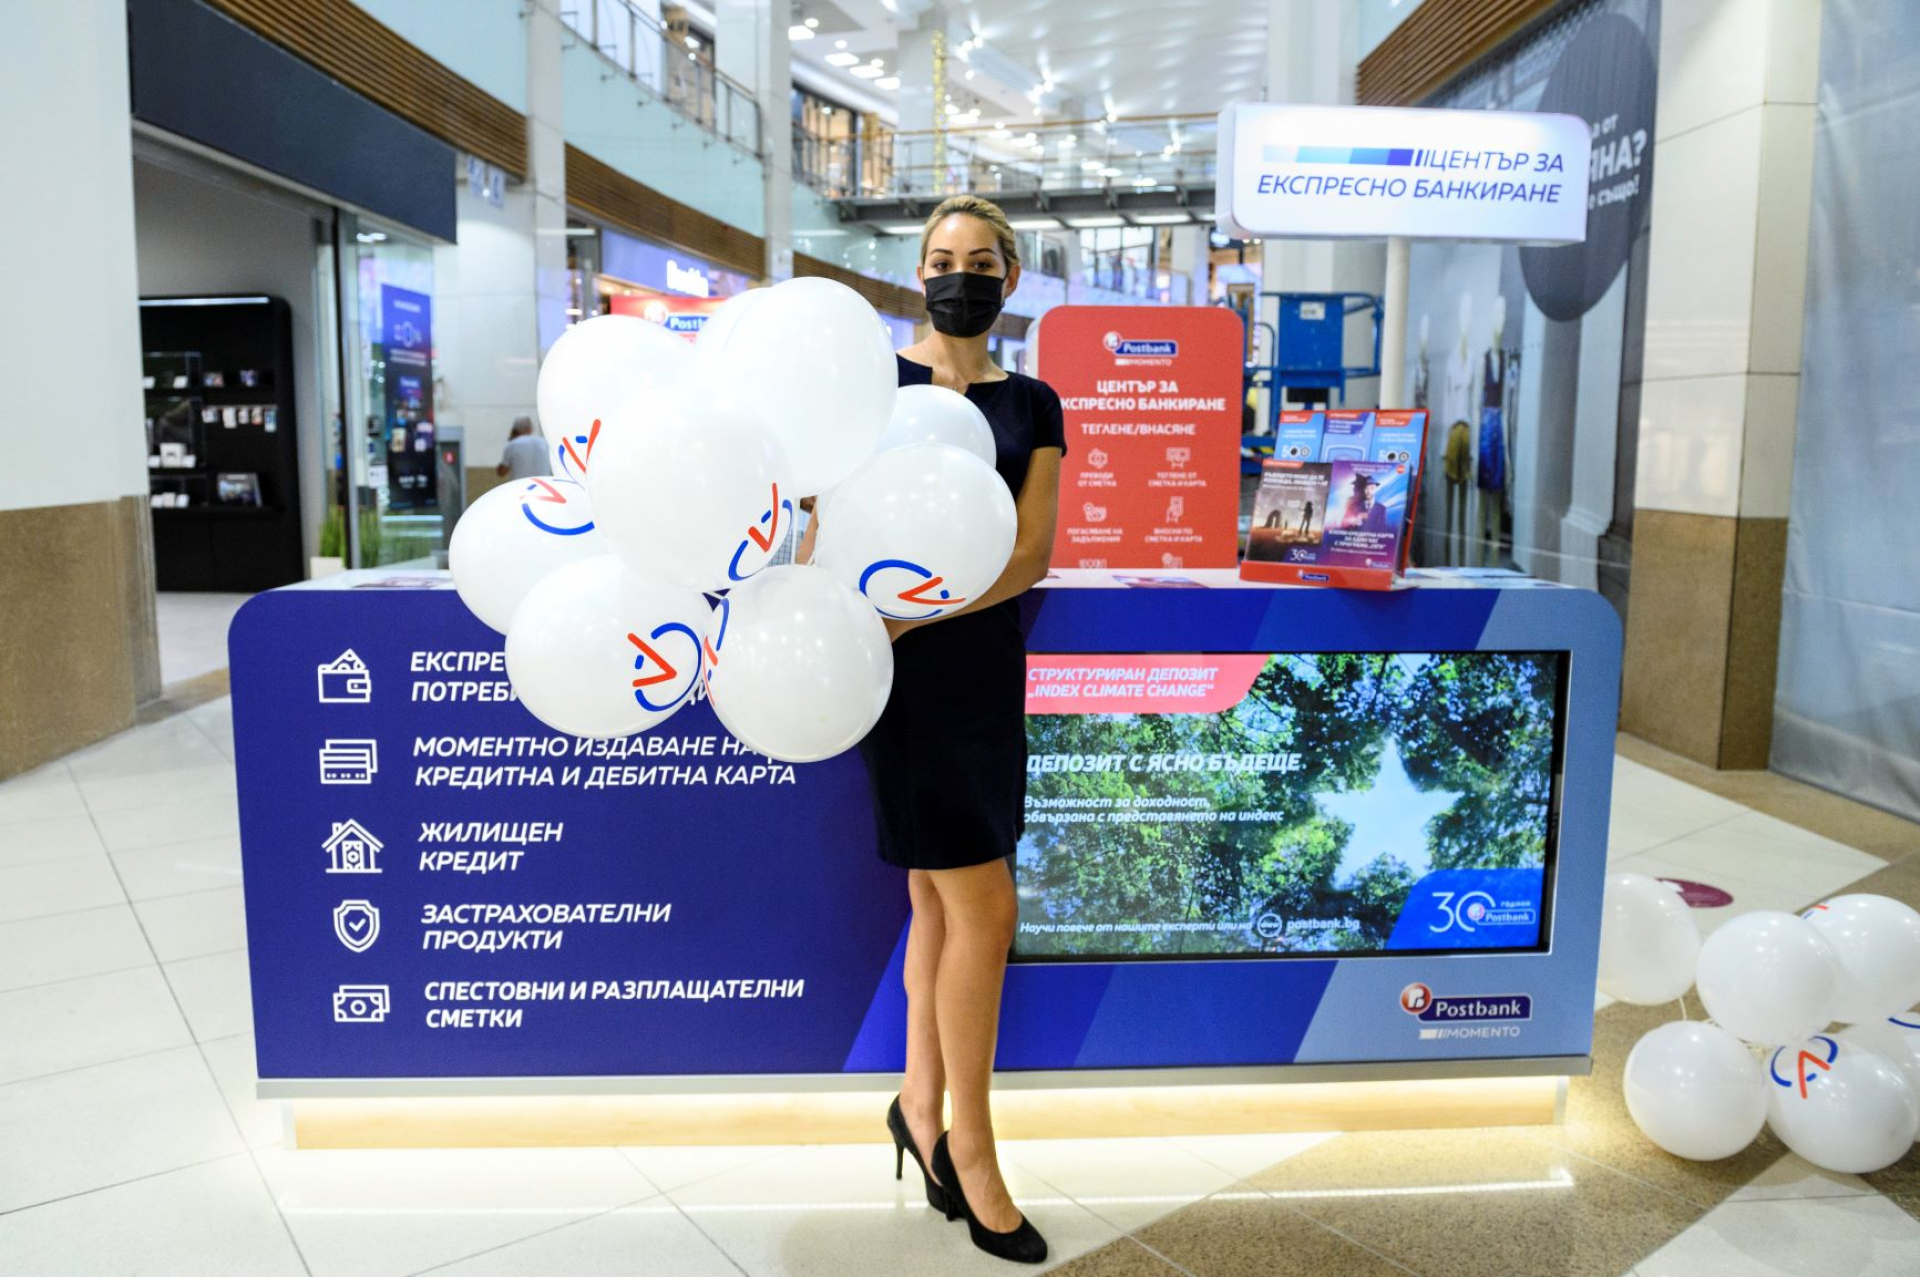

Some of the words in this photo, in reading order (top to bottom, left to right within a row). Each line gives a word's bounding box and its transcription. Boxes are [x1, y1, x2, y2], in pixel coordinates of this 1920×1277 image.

[1429, 149, 1529, 175] ЦЕНТЪР
[1534, 153, 1564, 173] ЗА
[1257, 174, 1407, 198] ЕКСПРЕСНО
[1413, 179, 1562, 203] БАНКИРАНЕ
[669, 317, 703, 330] Post
[1123, 342, 1172, 353] Postbank
[1097, 380, 1154, 395] ЦЕНТЪР
[1159, 380, 1178, 393] ЗА
[1060, 397, 1135, 411] КСПРЕСНО
[1138, 398, 1226, 411] БАНКИРАНЕ
[1081, 423, 1196, 436] ТЕГЛЕНЕ/ВНАСЯНЕ
[410, 651, 506, 672] ЕКСПРЕ
[1028, 667, 1146, 681] СТРУКТУРИРАН
[1147, 667, 1218, 683] ДЕПОЗИТ
[1082, 684, 1145, 697] CLIMATE
[412, 737, 569, 757] МОМЕНТНО
[573, 736, 718, 760] ИЗДАВАНЕ
[1026, 754, 1127, 773] ДЕПОЗИТ
[1129, 754, 1144, 772] С
[1146, 754, 1205, 772] ЯСНО
[1208, 753, 1303, 775] БЪДЕЩЕ
[415, 766, 555, 790] КРЕДИТНА
[561, 766, 581, 786] И
[584, 766, 709, 790] ДЕБИТНА
[714, 765, 797, 785] КАРТА
[1024, 795, 1112, 809] Възможност
[1114, 797, 1130, 808] за
[1132, 795, 1211, 809] доходност,
[1024, 811, 1095, 824] обвързана
[1098, 812, 1105, 822] с
[1107, 811, 1217, 824] представянето
[1219, 812, 1236, 822] на
[1238, 811, 1285, 822] индекс
[418, 822, 564, 846] ЖИЛИЩЕН
[418, 852, 524, 875] КРЕДИТ
[421, 903, 672, 925] ЗАСТРАХОВАТЕЛНИ
[1485, 912, 1530, 922] Postbank
[1020, 922, 1056, 935] Научи
[1056, 924, 1094, 933] повече
[1095, 924, 1113, 932] от
[1114, 923, 1161, 932] нашите
[1287, 917, 1360, 932] postbank.bg
[422, 930, 563, 954] ПРОДУКТИ
[424, 982, 565, 1002] СПЕСТОВНИ
[569, 982, 588, 1001] И
[591, 978, 805, 1003] РАЗПЛАЩАТЕЛНИ
[1435, 999, 1522, 1018] Postbank
[426, 1008, 523, 1029] СМЕТКИ
[1446, 1026, 1521, 1039] MOMENTO
